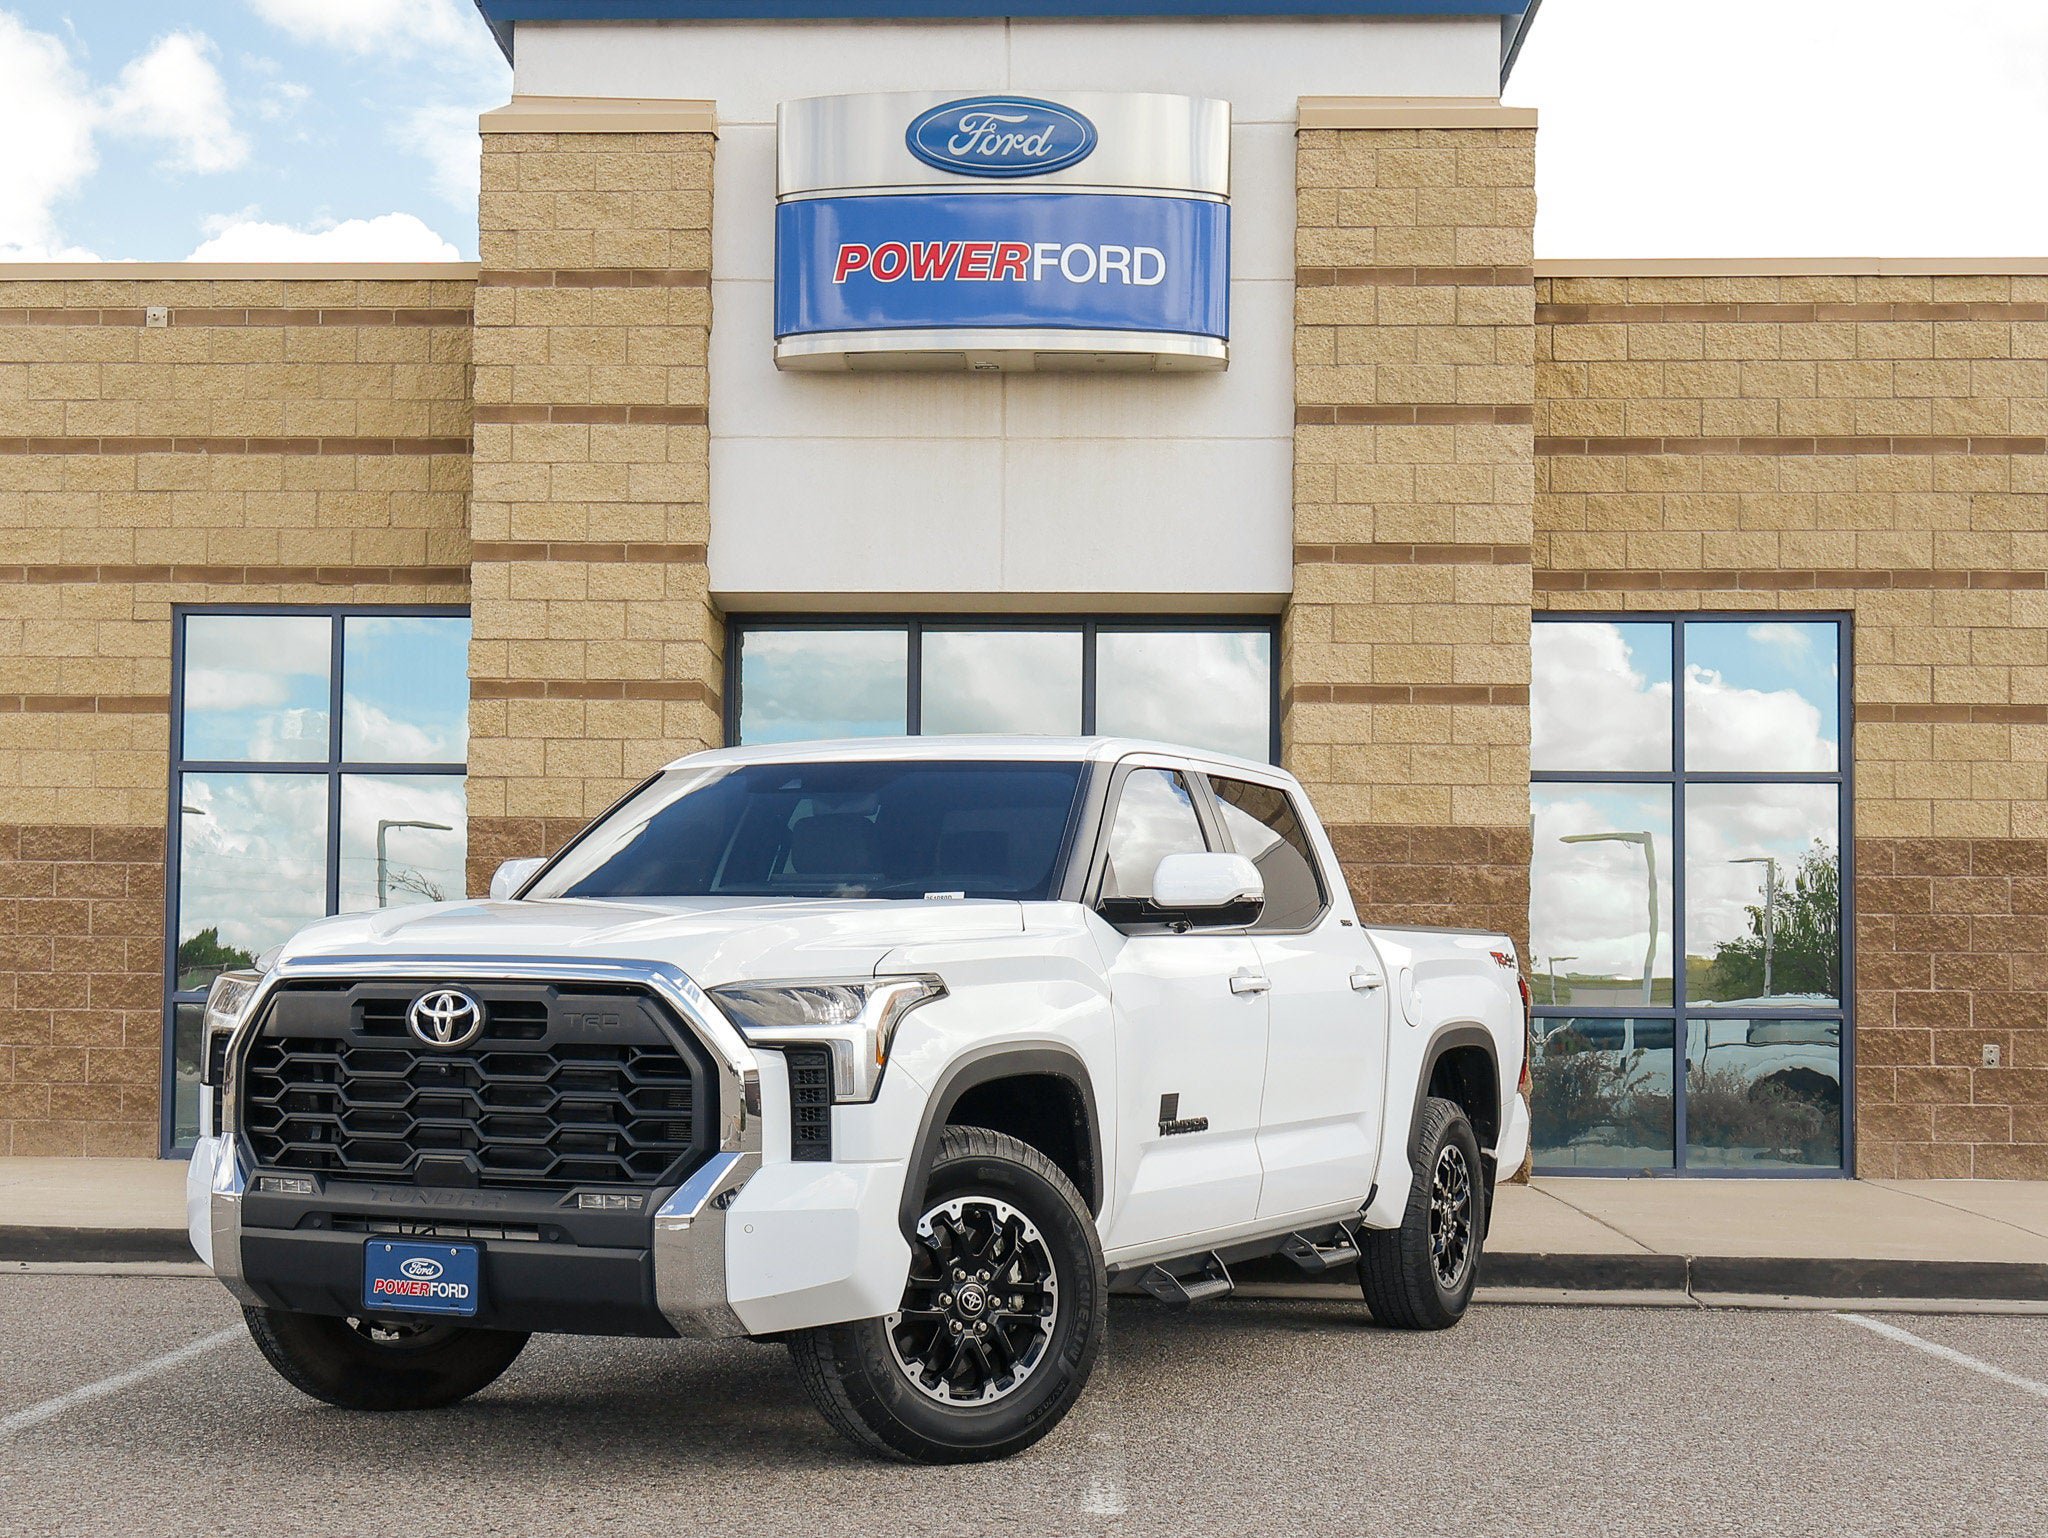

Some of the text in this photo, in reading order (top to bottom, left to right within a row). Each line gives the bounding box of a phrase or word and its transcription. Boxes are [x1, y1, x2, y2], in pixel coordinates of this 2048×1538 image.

[948, 112, 1054, 157] Ford
[832, 240, 1166, 287] POWERFORD
[563, 1012, 620, 1032] TRD
[408, 1261, 434, 1275] Ford
[373, 1278, 469, 1298] POWERFORD
